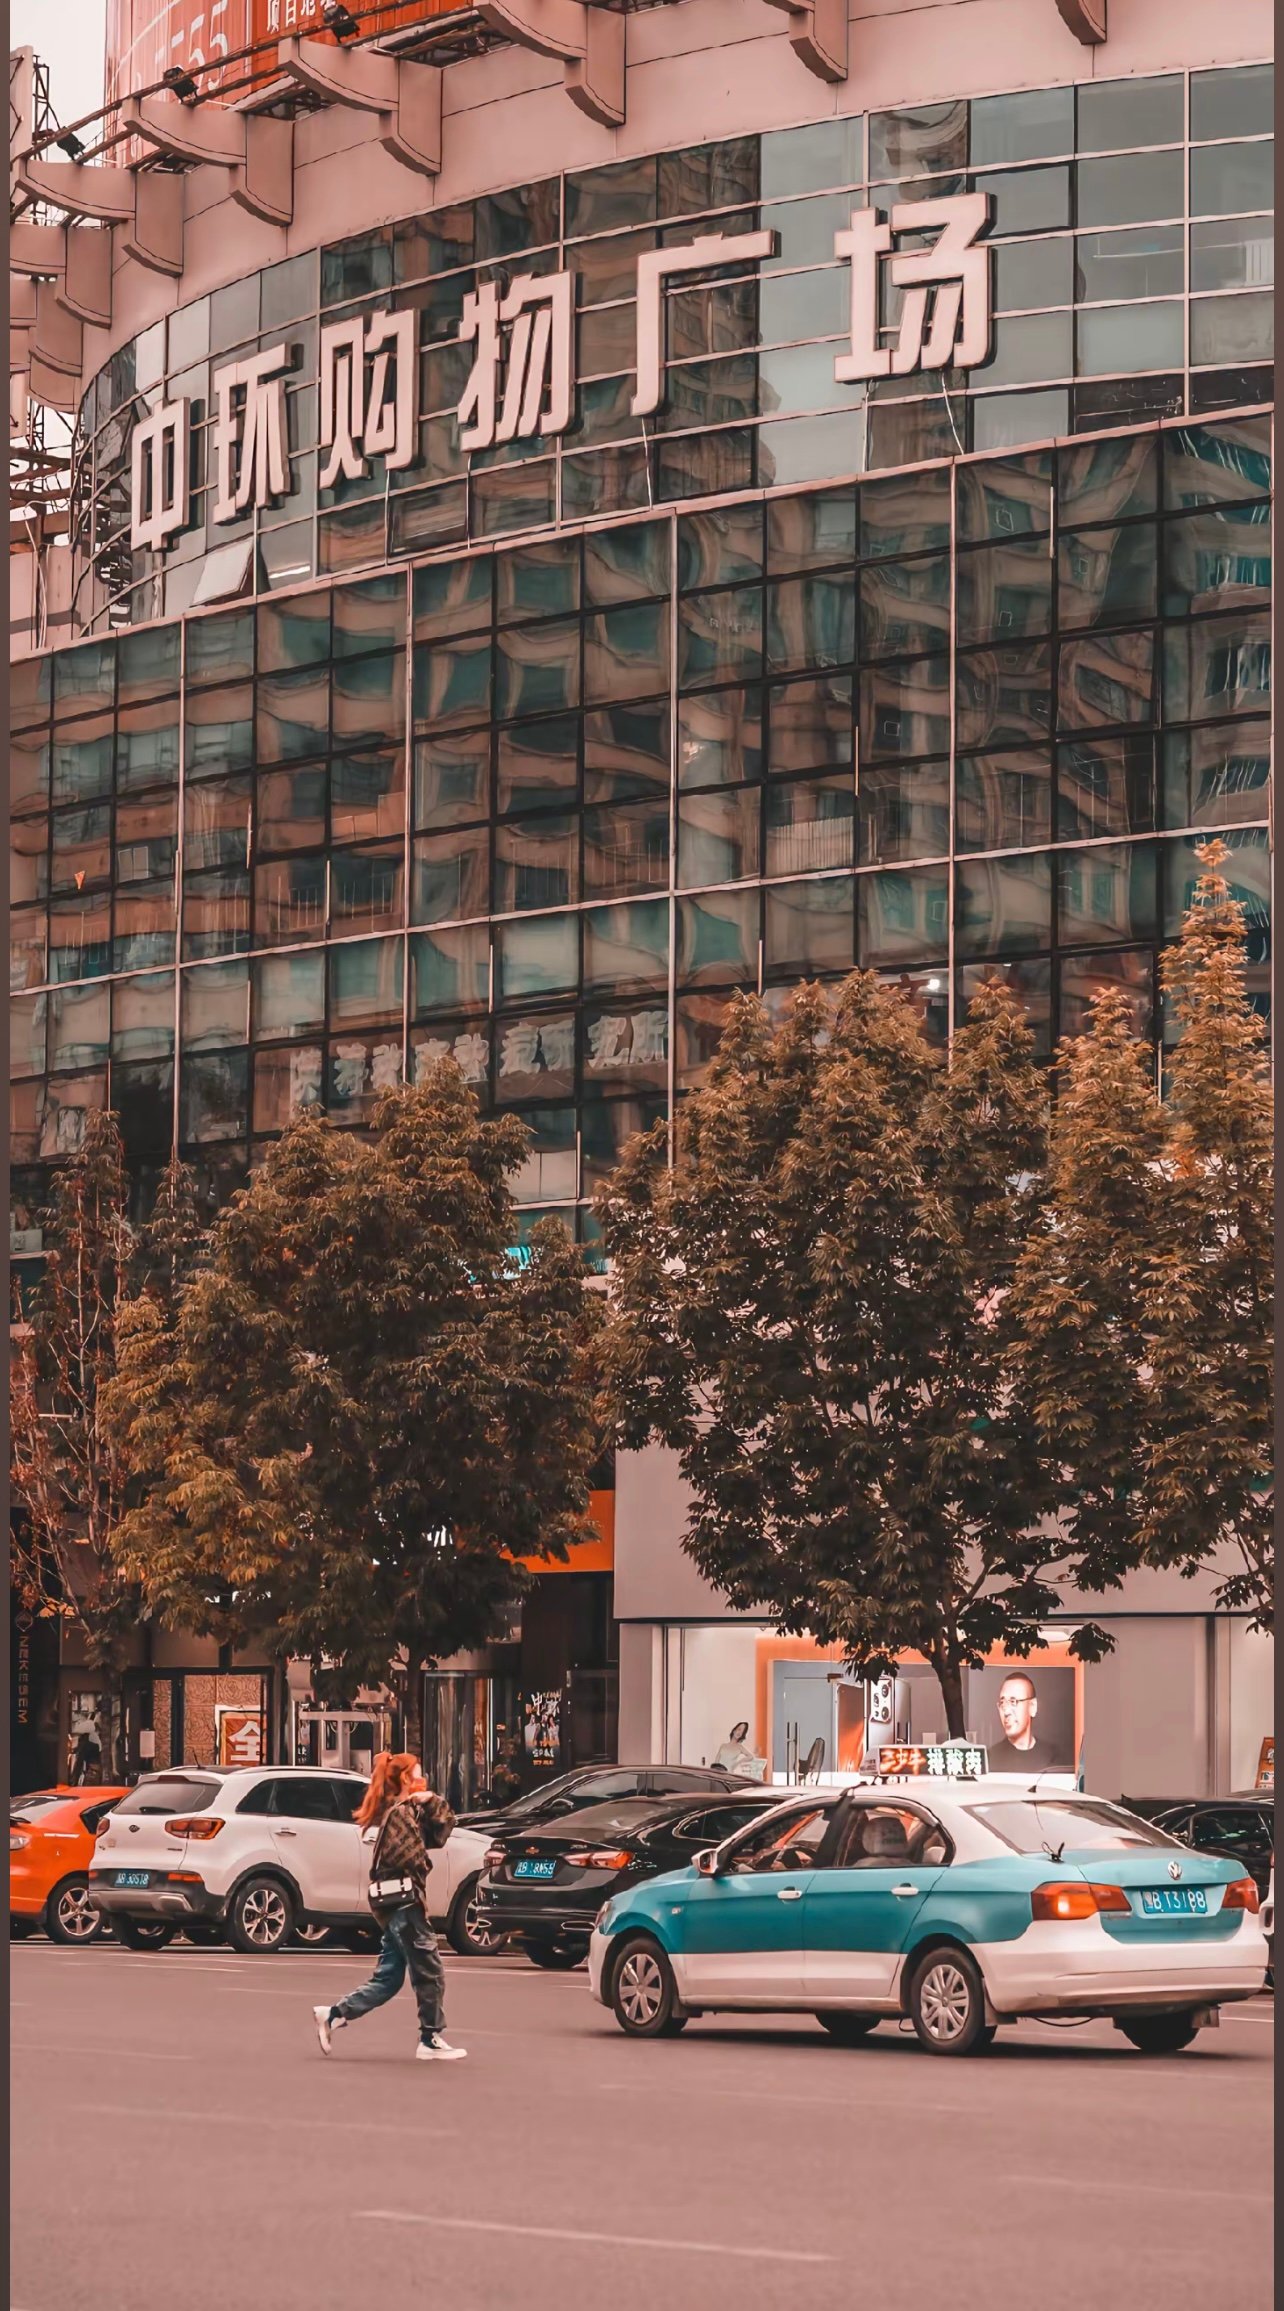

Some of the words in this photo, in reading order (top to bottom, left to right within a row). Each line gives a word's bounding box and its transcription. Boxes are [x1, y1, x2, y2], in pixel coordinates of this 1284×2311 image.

[131, 192, 992, 552] 中环购物广场
[18, 1635, 29, 1724] NEKESEM
[228, 1720, 261, 1762] 全
[1143, 1890, 1206, 1909] BT3188
